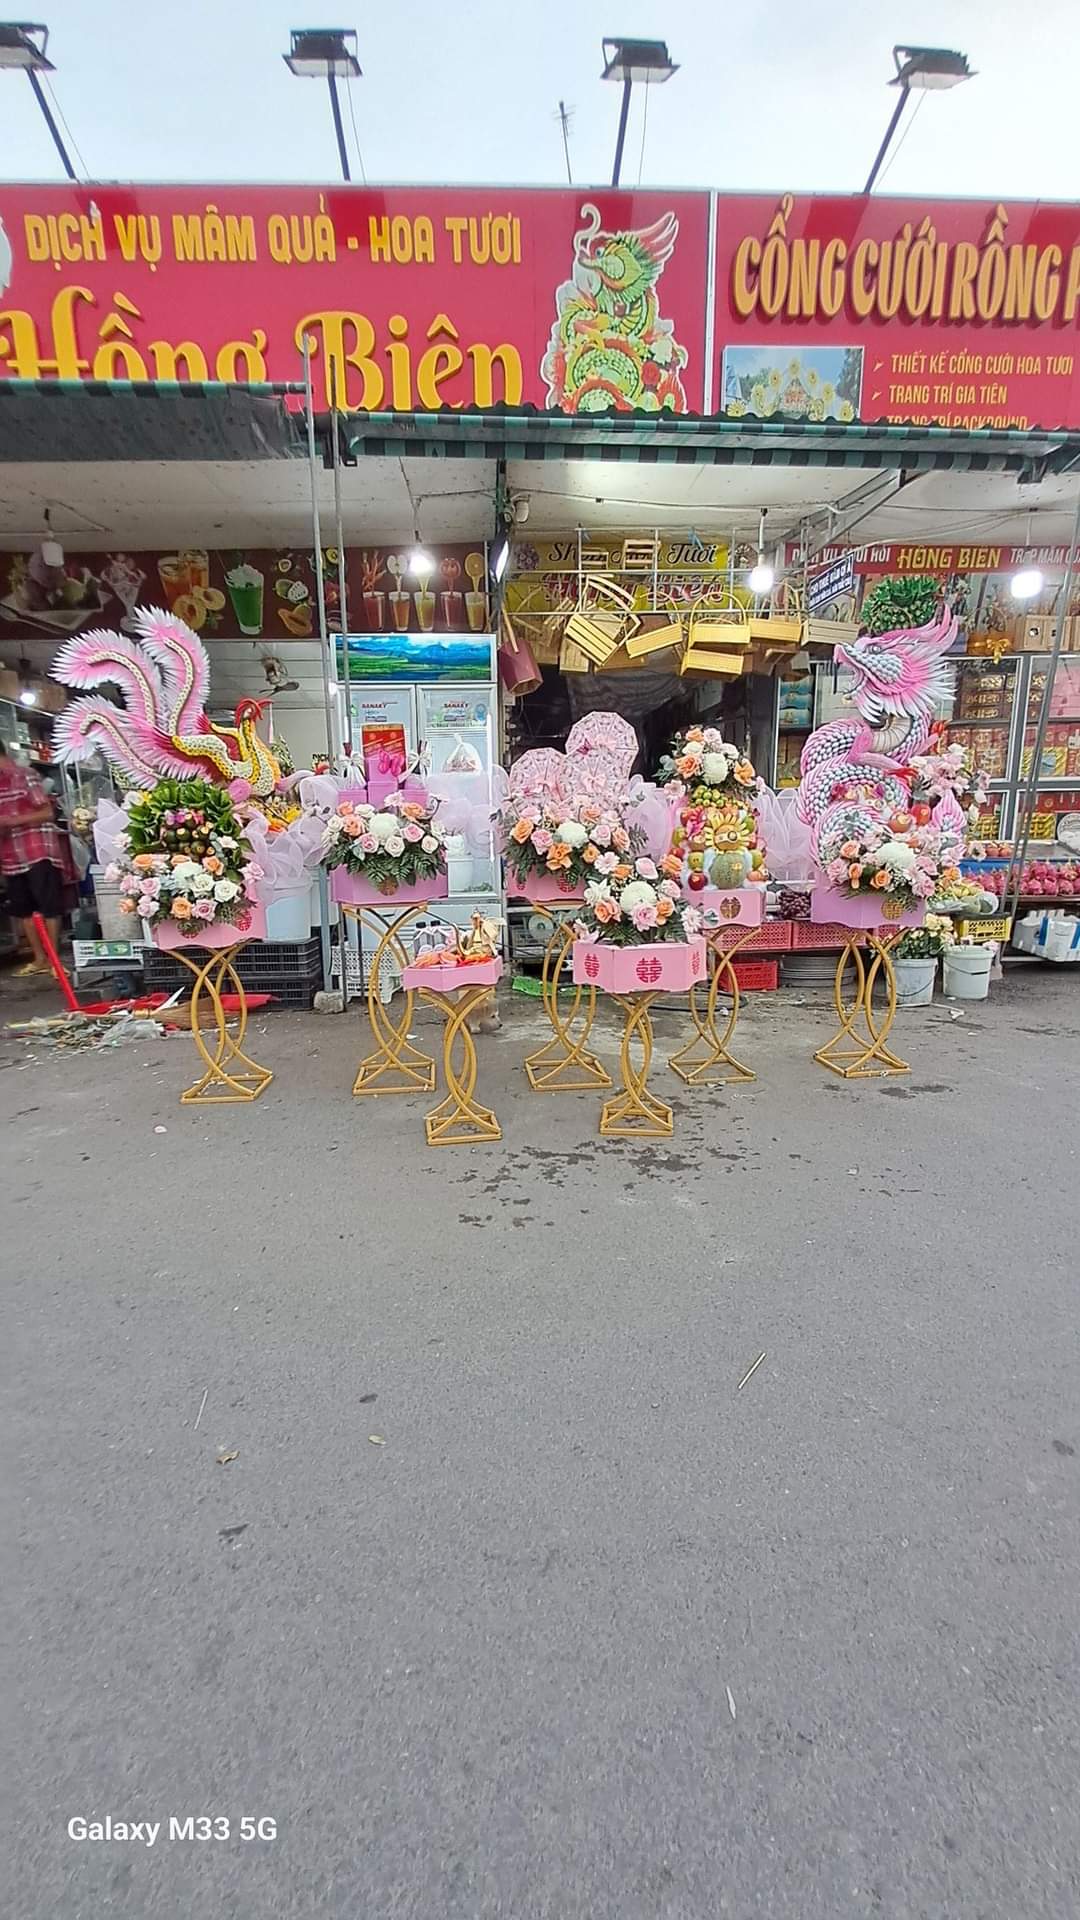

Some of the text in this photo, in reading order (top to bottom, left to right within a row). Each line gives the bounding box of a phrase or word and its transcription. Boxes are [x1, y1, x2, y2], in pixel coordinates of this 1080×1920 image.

[24, 213, 106, 271] DỊCH
[113, 214, 162, 272] VỤ
[172, 204, 257, 262] MÂM
[267, 193, 336, 264] QUẢ
[369, 215, 435, 263] HOA
[445, 211, 521, 265] TƯƠI
[733, 193, 846, 318] CỔNG
[851, 215, 948, 319] CƯỚI
[951, 203, 1062, 320] RỒNG
[295, 311, 524, 412] Biên
[889, 382, 1008, 404] TRANG TRÍ GIA TIÊN
[891, 348, 1074, 376] THIẾT KẾ CỔNG CƯỚI HOA TƯƠI
